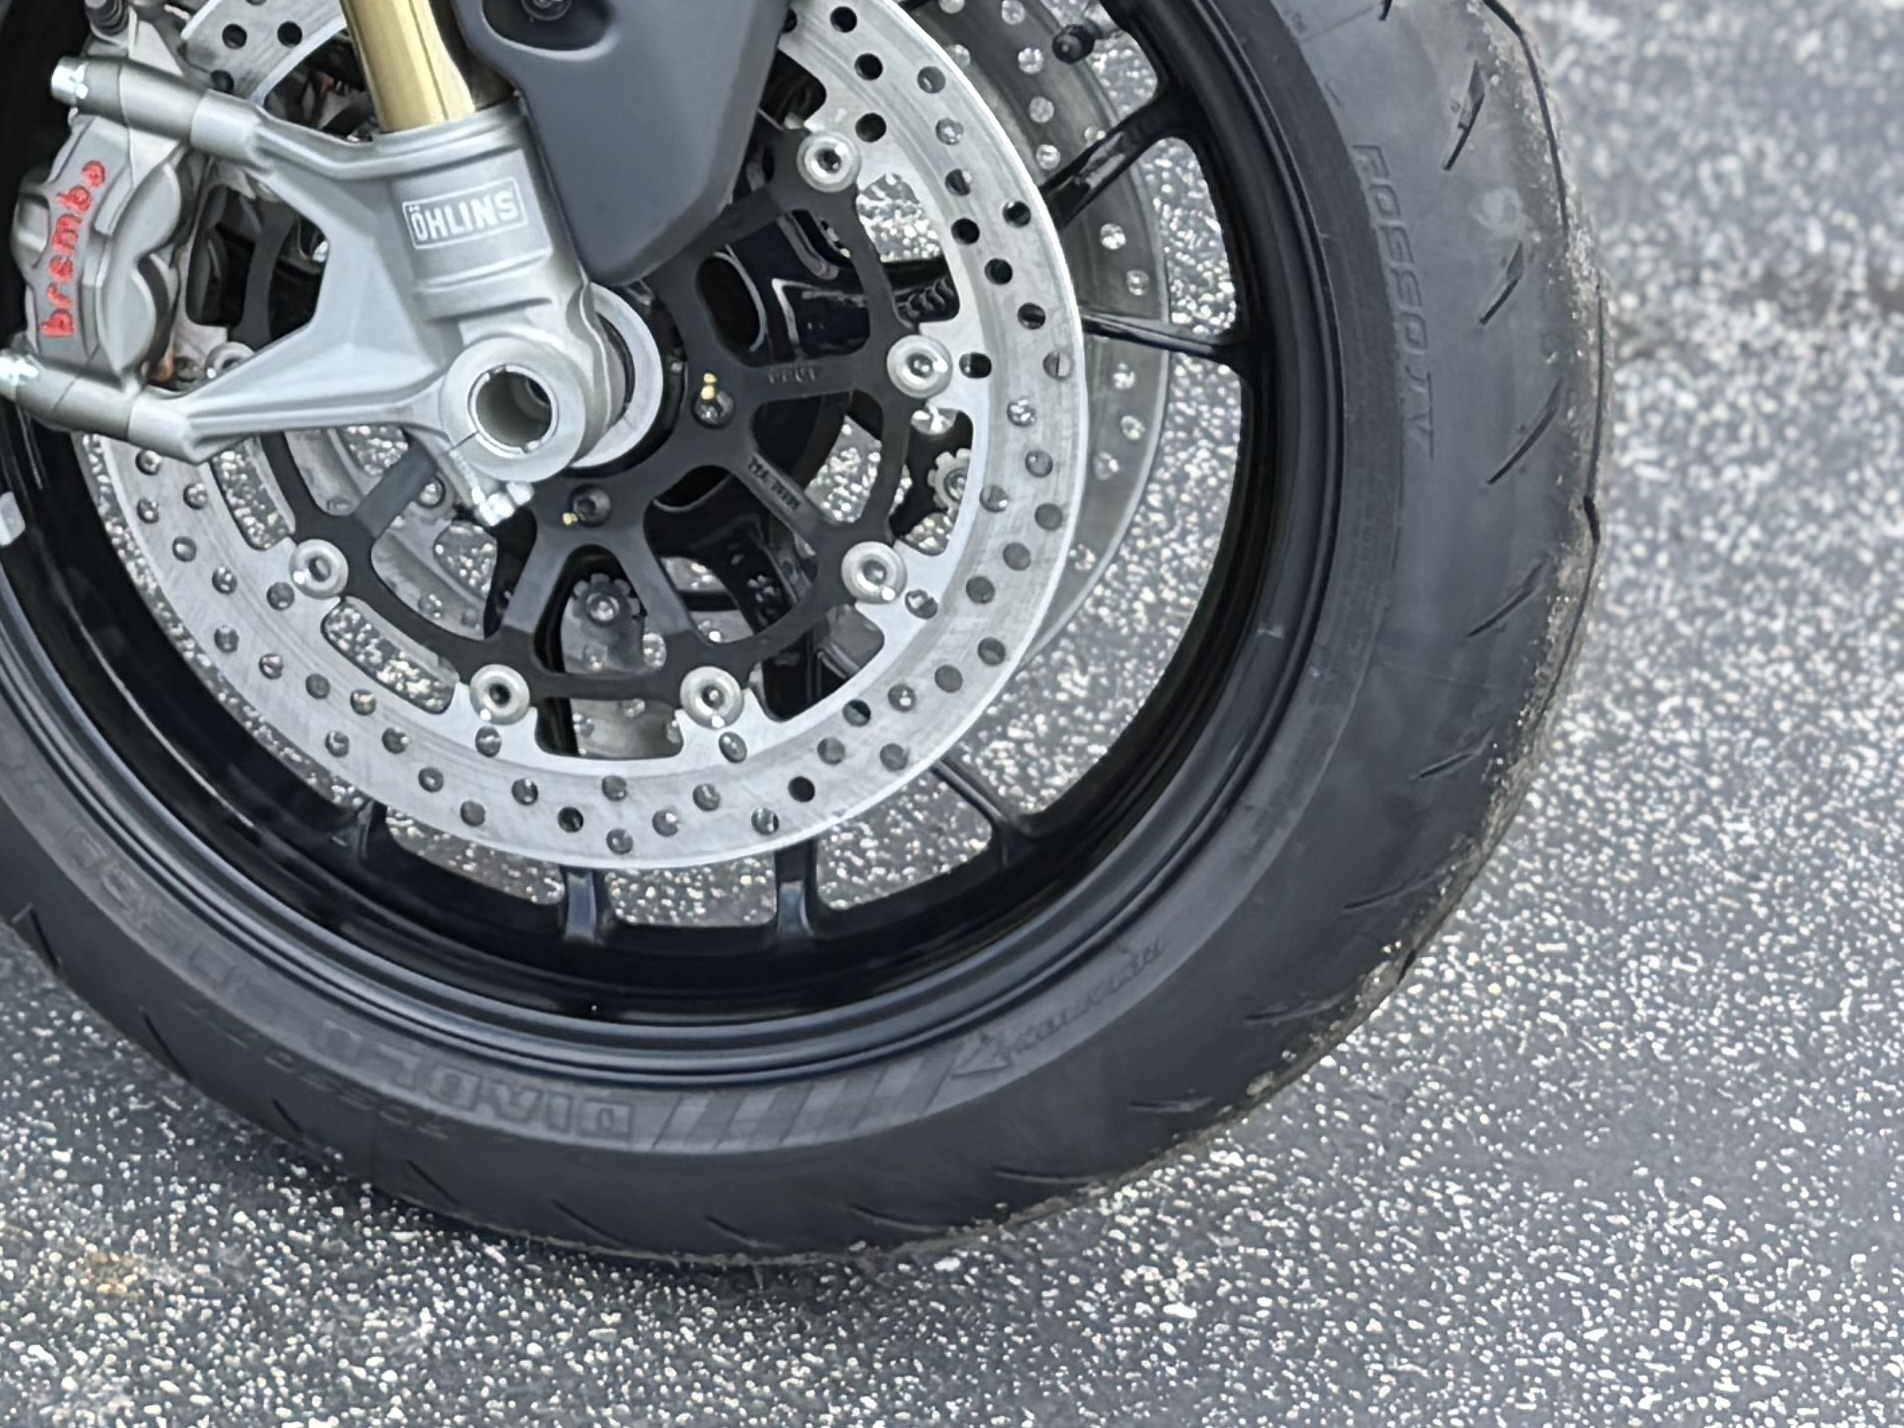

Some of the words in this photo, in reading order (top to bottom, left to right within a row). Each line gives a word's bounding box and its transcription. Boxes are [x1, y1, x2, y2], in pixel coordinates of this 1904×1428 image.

[40, 160, 107, 338] brembo
[409, 191, 519, 242] ÖHLINS
[1351, 144, 1429, 355] ROSSO
[308, 1017, 633, 1140] DIABLO
